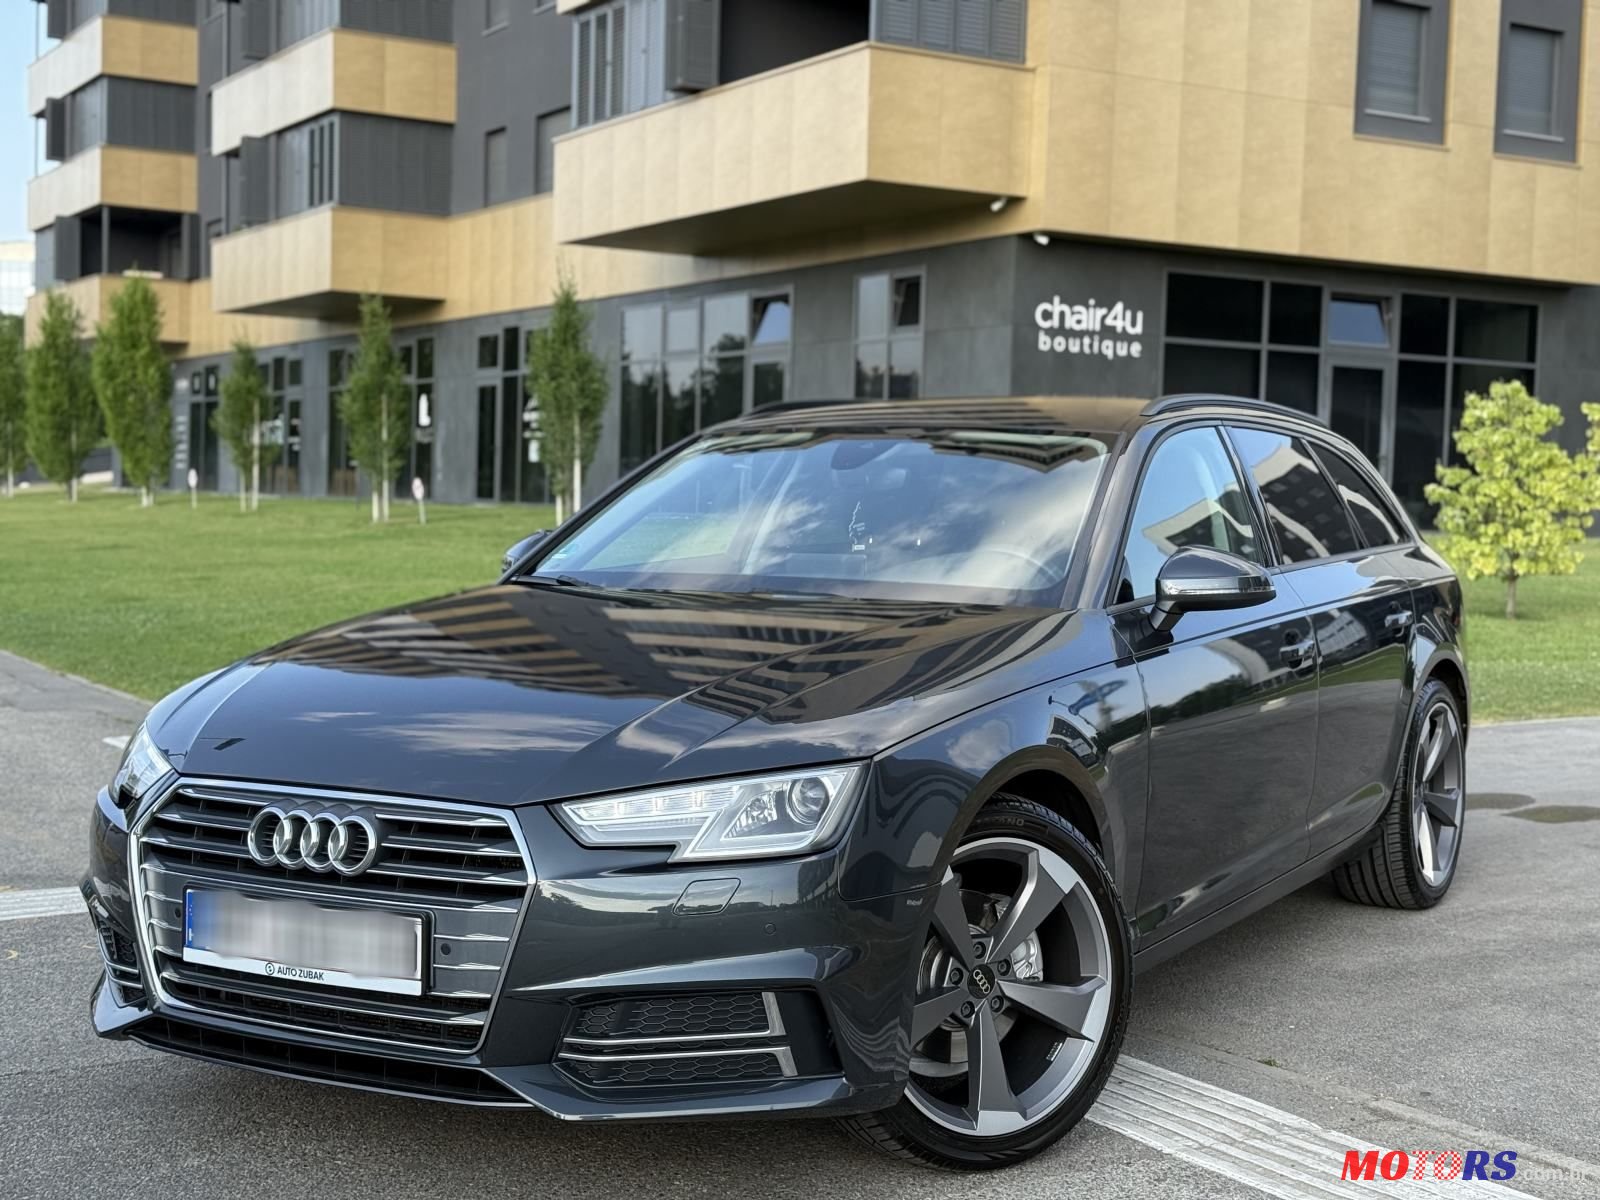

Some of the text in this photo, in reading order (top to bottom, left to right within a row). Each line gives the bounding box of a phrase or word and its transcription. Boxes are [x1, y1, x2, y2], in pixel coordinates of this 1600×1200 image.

[1034, 294, 1144, 335] chair4u
[1038, 329, 1142, 360] boutique
[277, 966, 325, 980] AUTO ZUBAK
